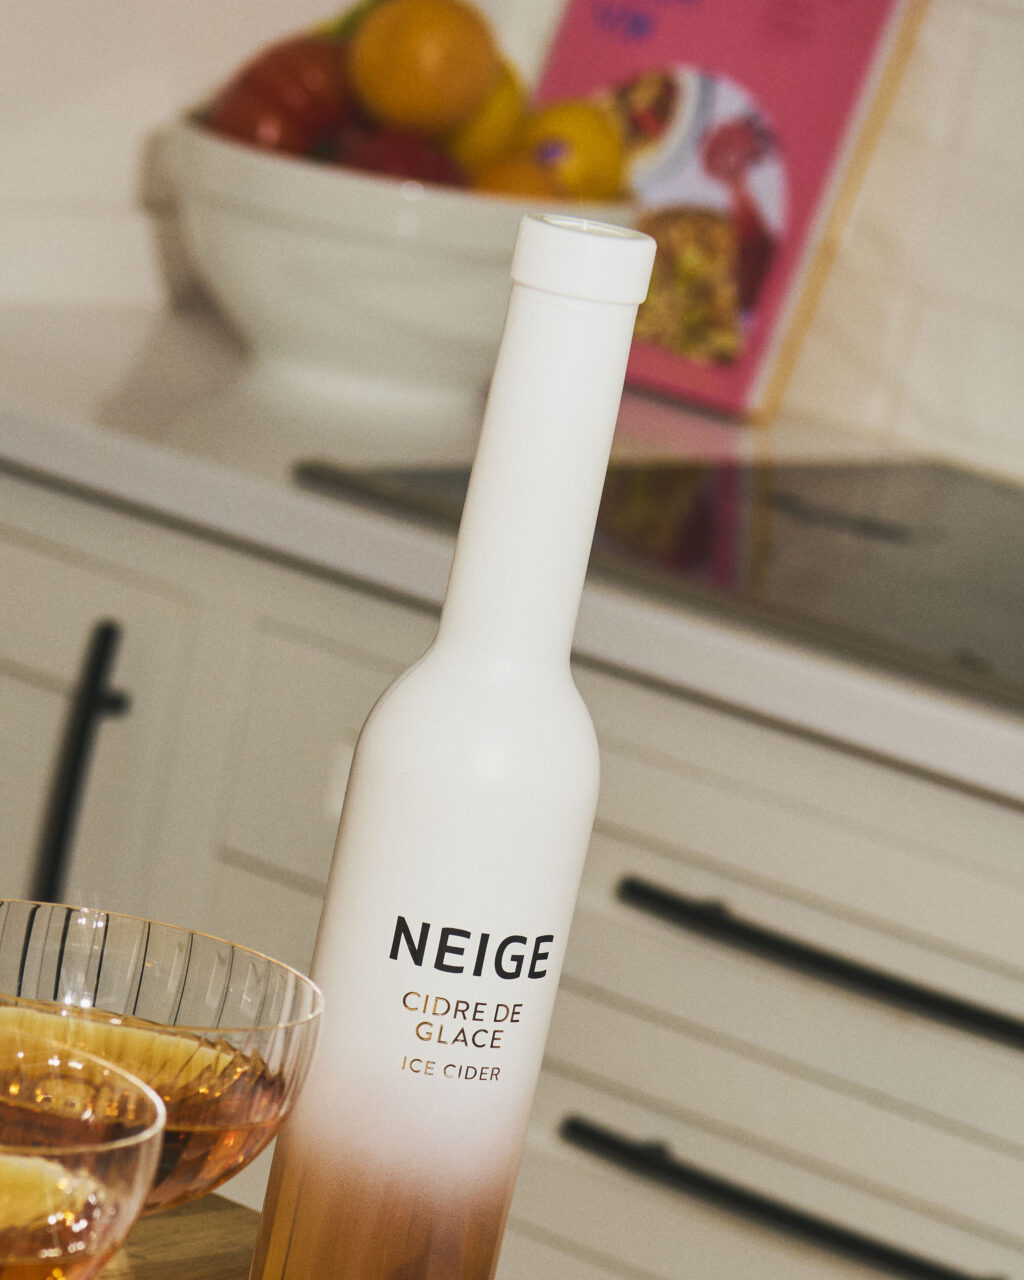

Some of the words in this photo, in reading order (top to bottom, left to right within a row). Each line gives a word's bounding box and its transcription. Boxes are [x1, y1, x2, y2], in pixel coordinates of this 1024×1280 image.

[389, 915, 554, 980] NEIGE
[402, 991, 487, 1021] CIDRE
[493, 1003, 523, 1023] DE
[415, 1021, 504, 1049] GLACE
[402, 1056, 436, 1076] ICE
[443, 1063, 501, 1081] CIDER
